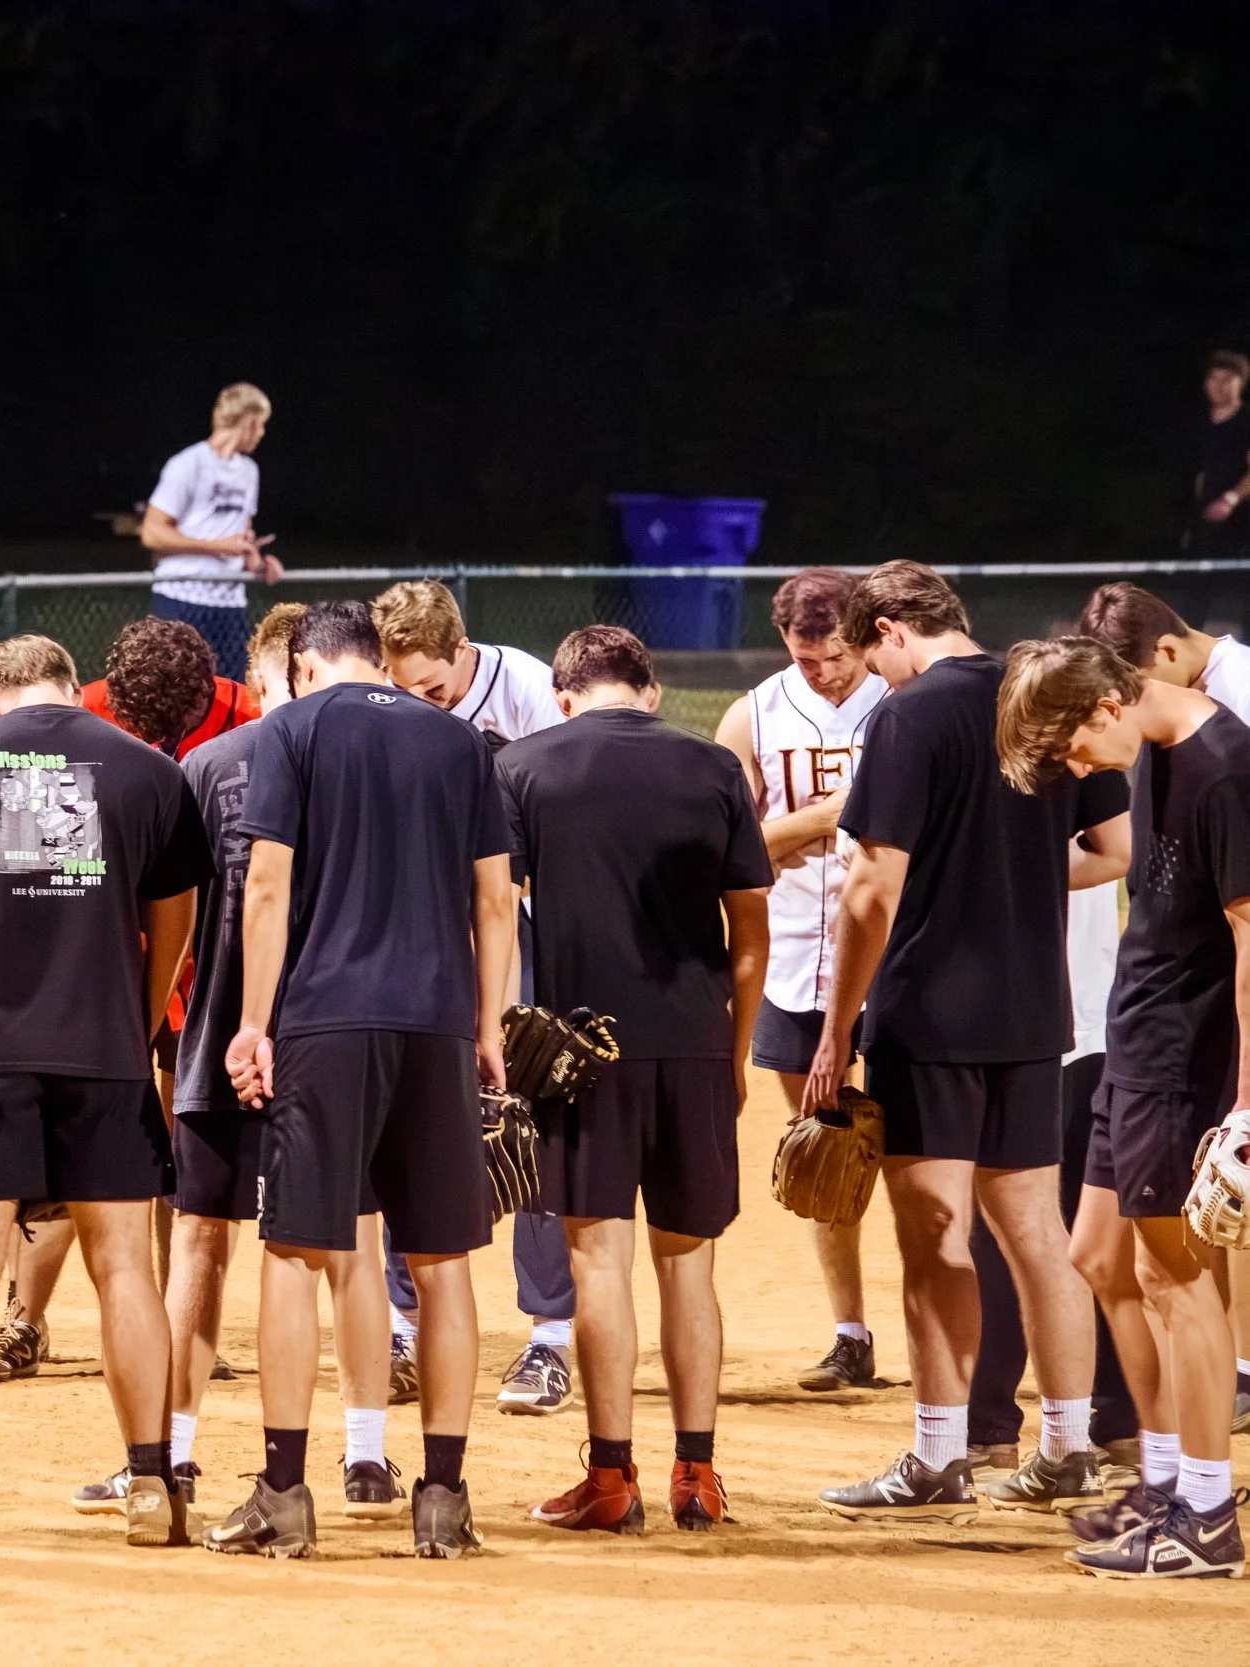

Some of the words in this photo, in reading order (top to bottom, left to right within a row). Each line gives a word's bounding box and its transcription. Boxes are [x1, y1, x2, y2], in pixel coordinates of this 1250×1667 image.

[62, 857, 107, 875] Week
[50, 875, 74, 886] 2010
[80, 875, 102, 886] 2011
[11, 888, 27, 896] LEE
[36, 888, 86, 897] UNIVERSITY
[1158, 1549, 1187, 1561] ALPHA
